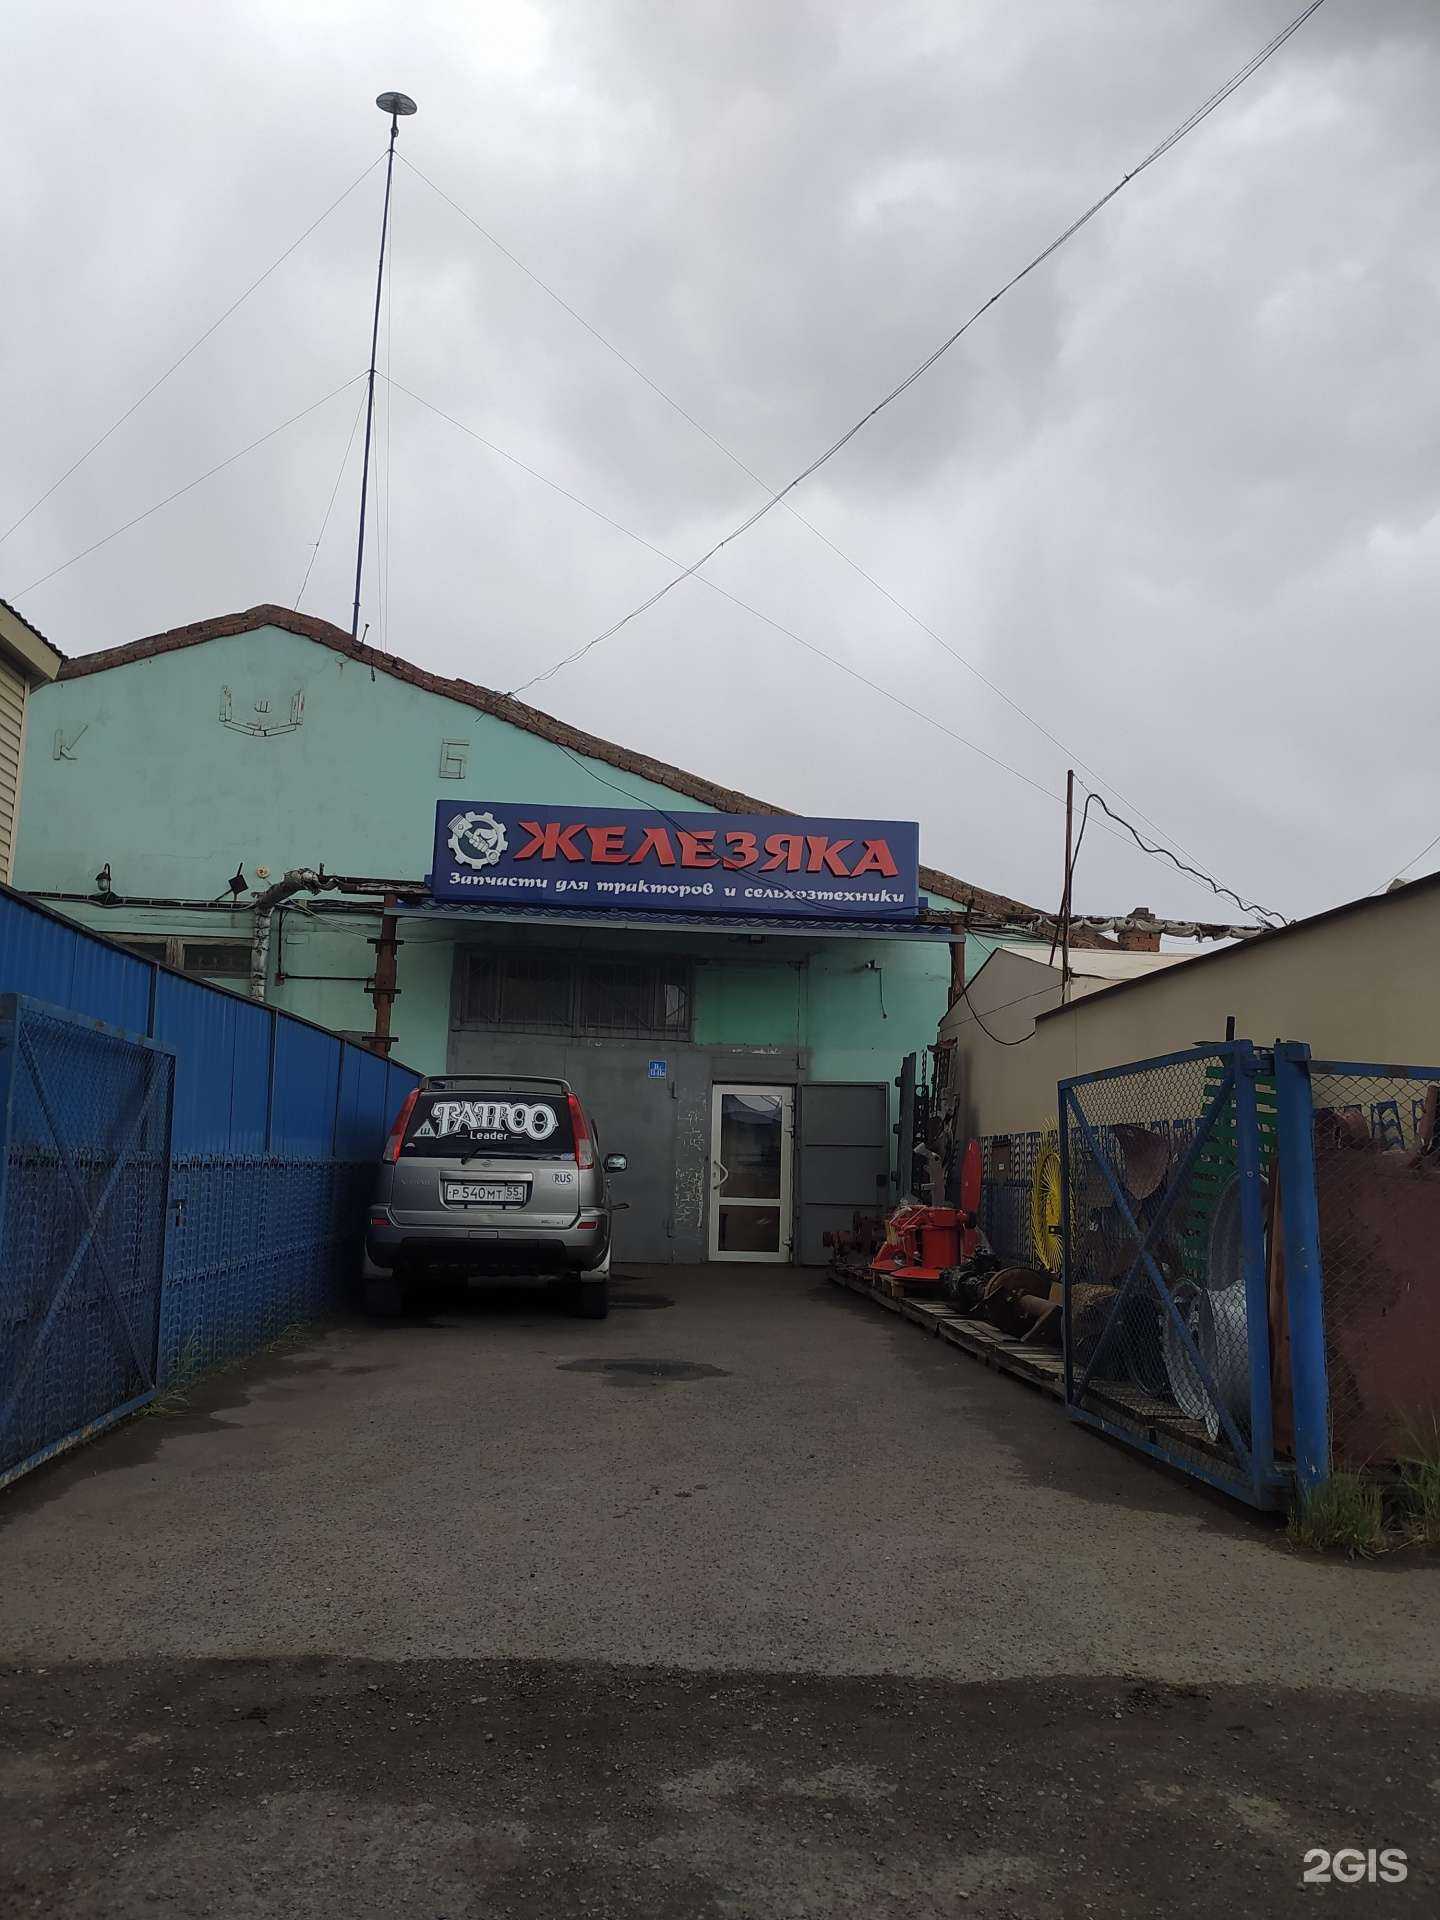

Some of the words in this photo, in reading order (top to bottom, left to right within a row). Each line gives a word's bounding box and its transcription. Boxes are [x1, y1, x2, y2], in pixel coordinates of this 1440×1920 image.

[513, 820, 899, 878] ЖЕЛЕЗЯКА
[449, 871, 548, 889] Запчасти
[555, 878, 589, 893] для
[596, 879, 714, 898] тракторов
[723, 886, 737, 898] и
[744, 886, 905, 904] сельхозтехники
[430, 1101, 559, 1141] TATTOO
[469, 1131, 509, 1141] Leader
[553, 1172, 572, 1184] RUS
